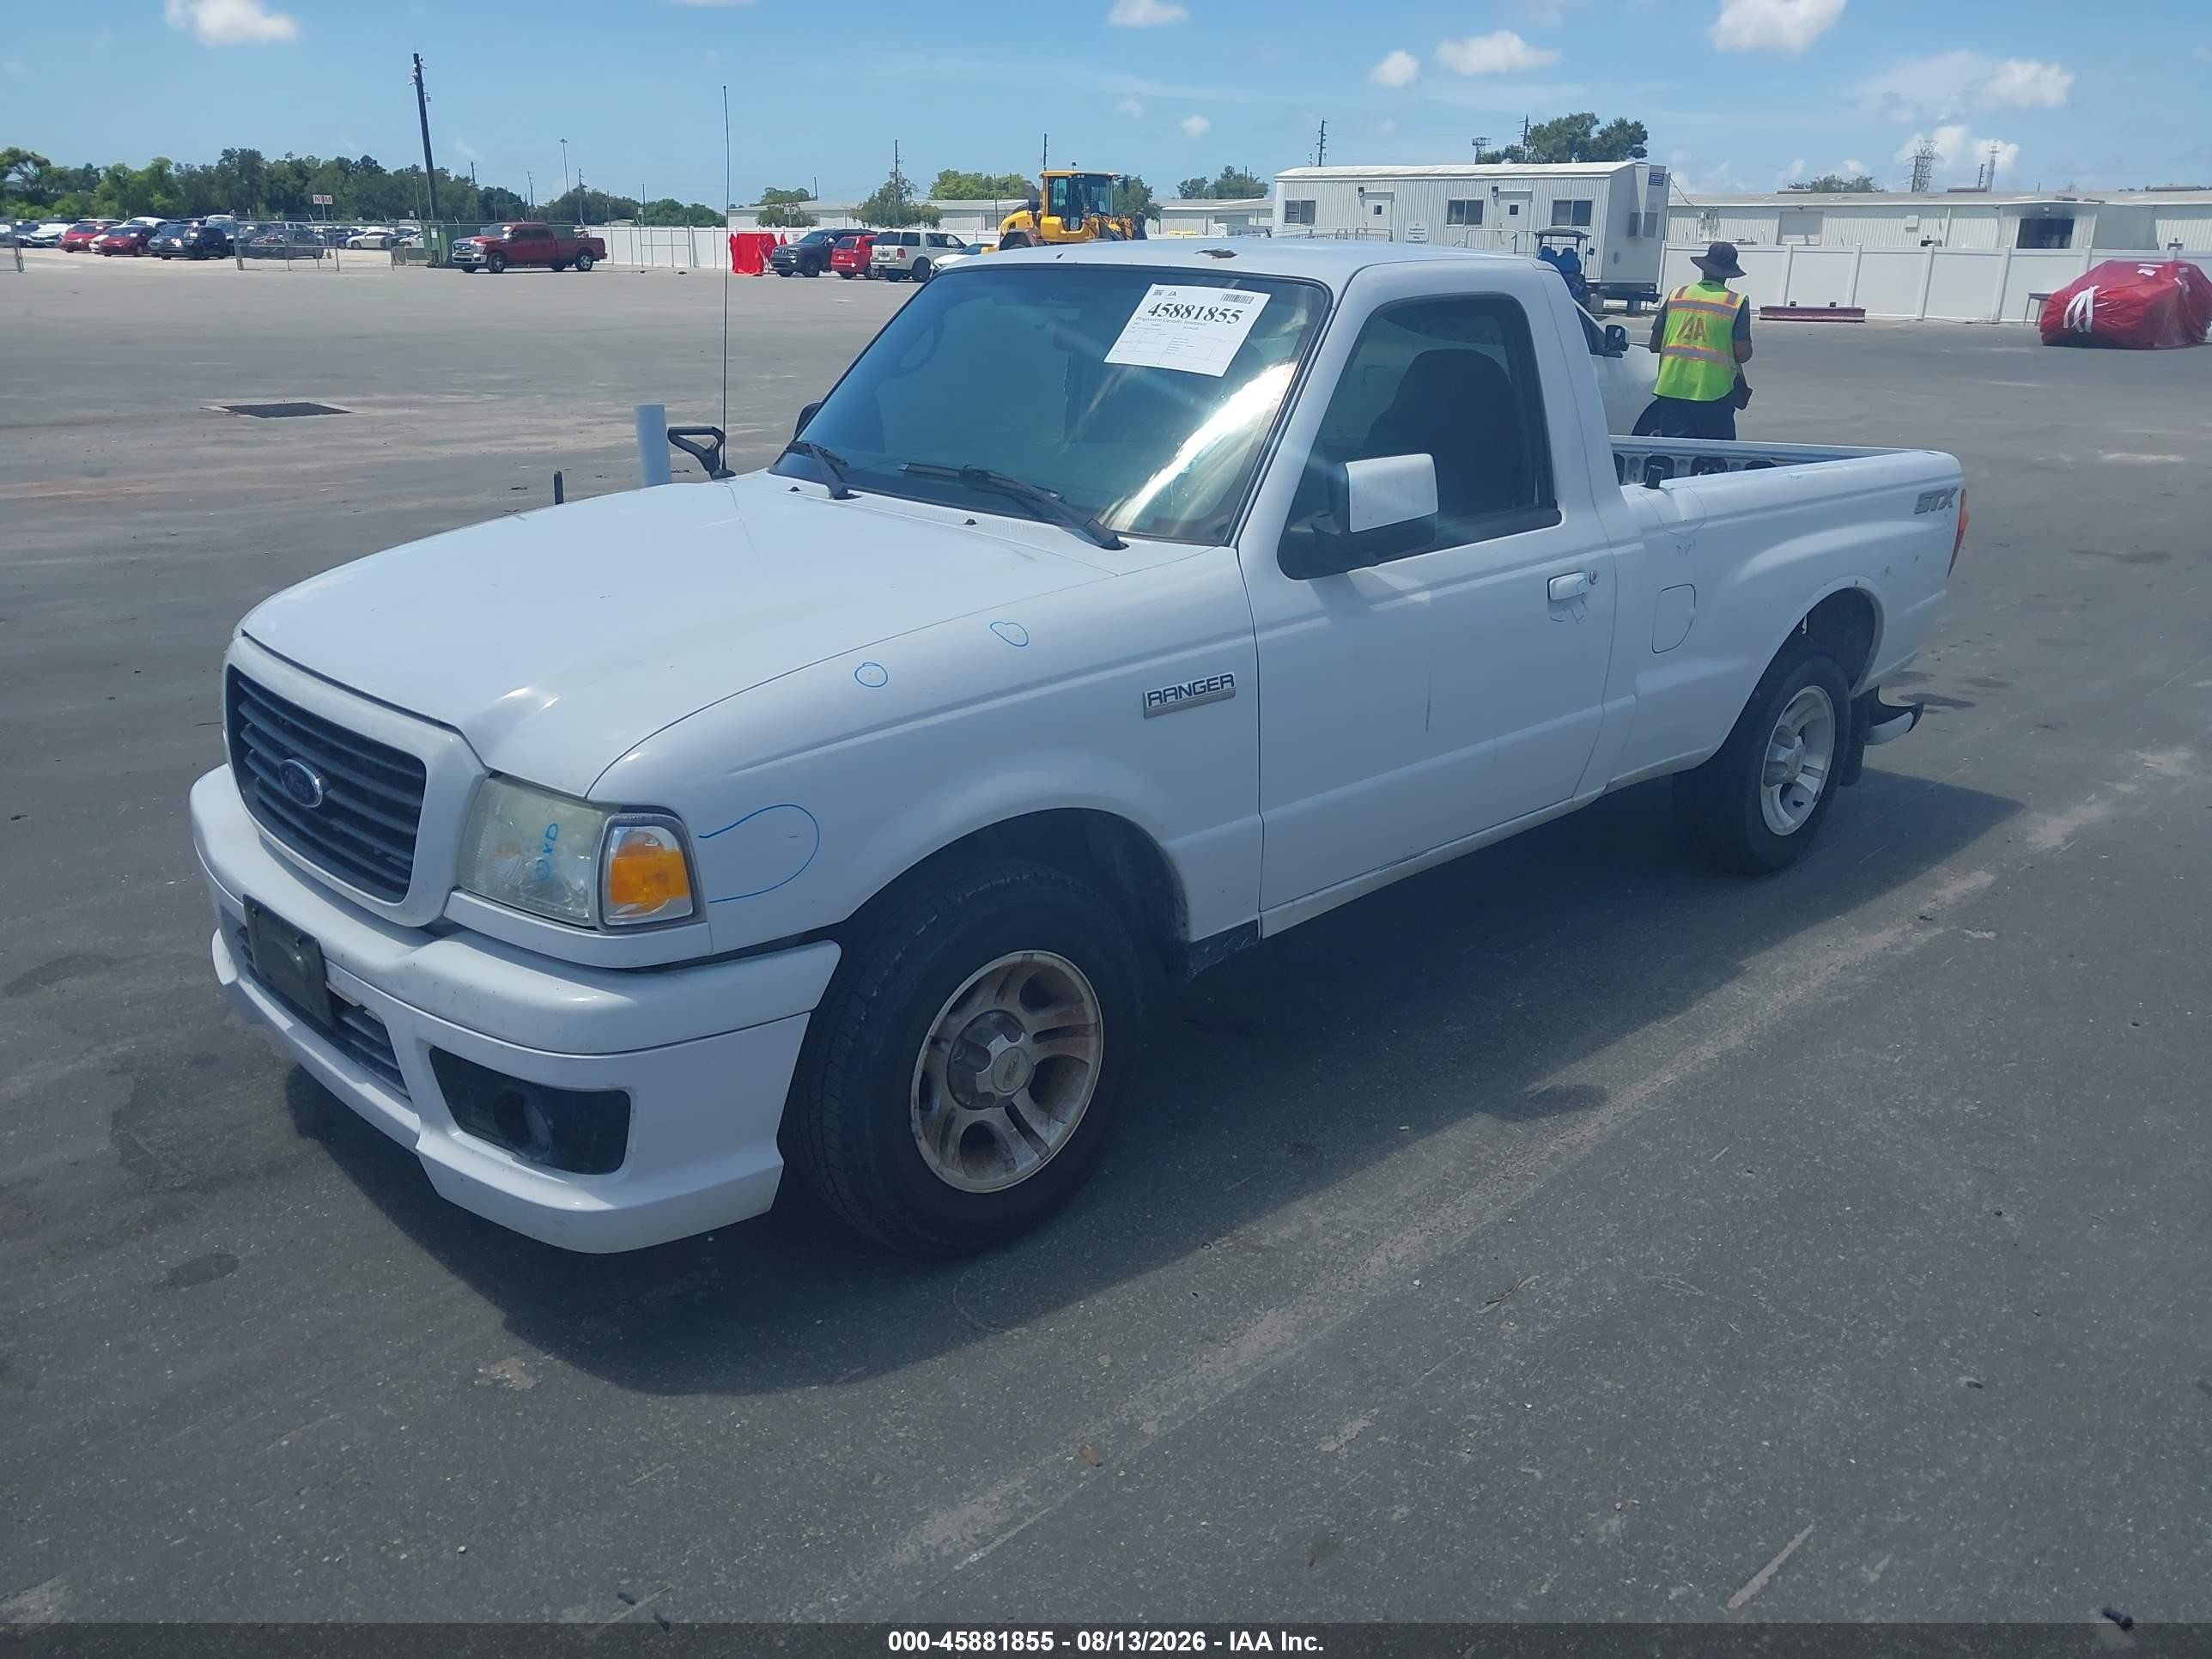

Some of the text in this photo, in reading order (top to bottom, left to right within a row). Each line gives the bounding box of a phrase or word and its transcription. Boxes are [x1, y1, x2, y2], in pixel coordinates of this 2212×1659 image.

[1147, 302, 1244, 325] 45881855
[1913, 486, 1959, 515] STX
[1146, 673, 1235, 707] RANGER
